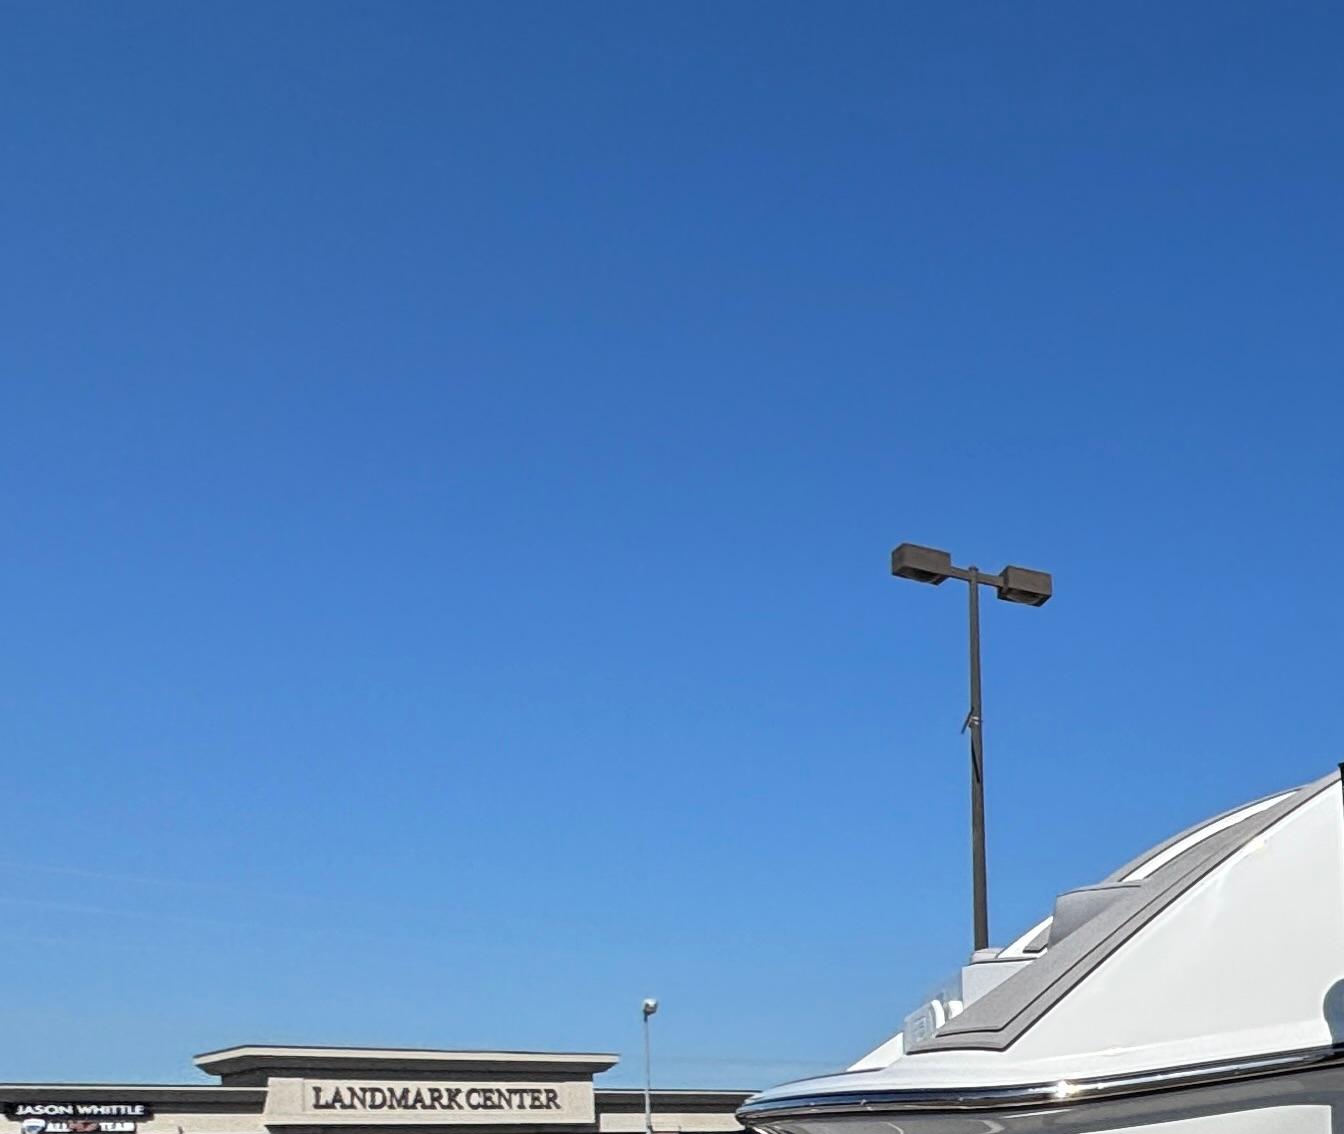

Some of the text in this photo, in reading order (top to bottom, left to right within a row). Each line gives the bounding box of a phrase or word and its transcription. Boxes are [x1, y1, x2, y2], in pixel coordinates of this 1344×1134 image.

[312, 1086, 562, 1111] LANDMARK CENTER
[16, 1105, 145, 1115] JASON WHITTLE
